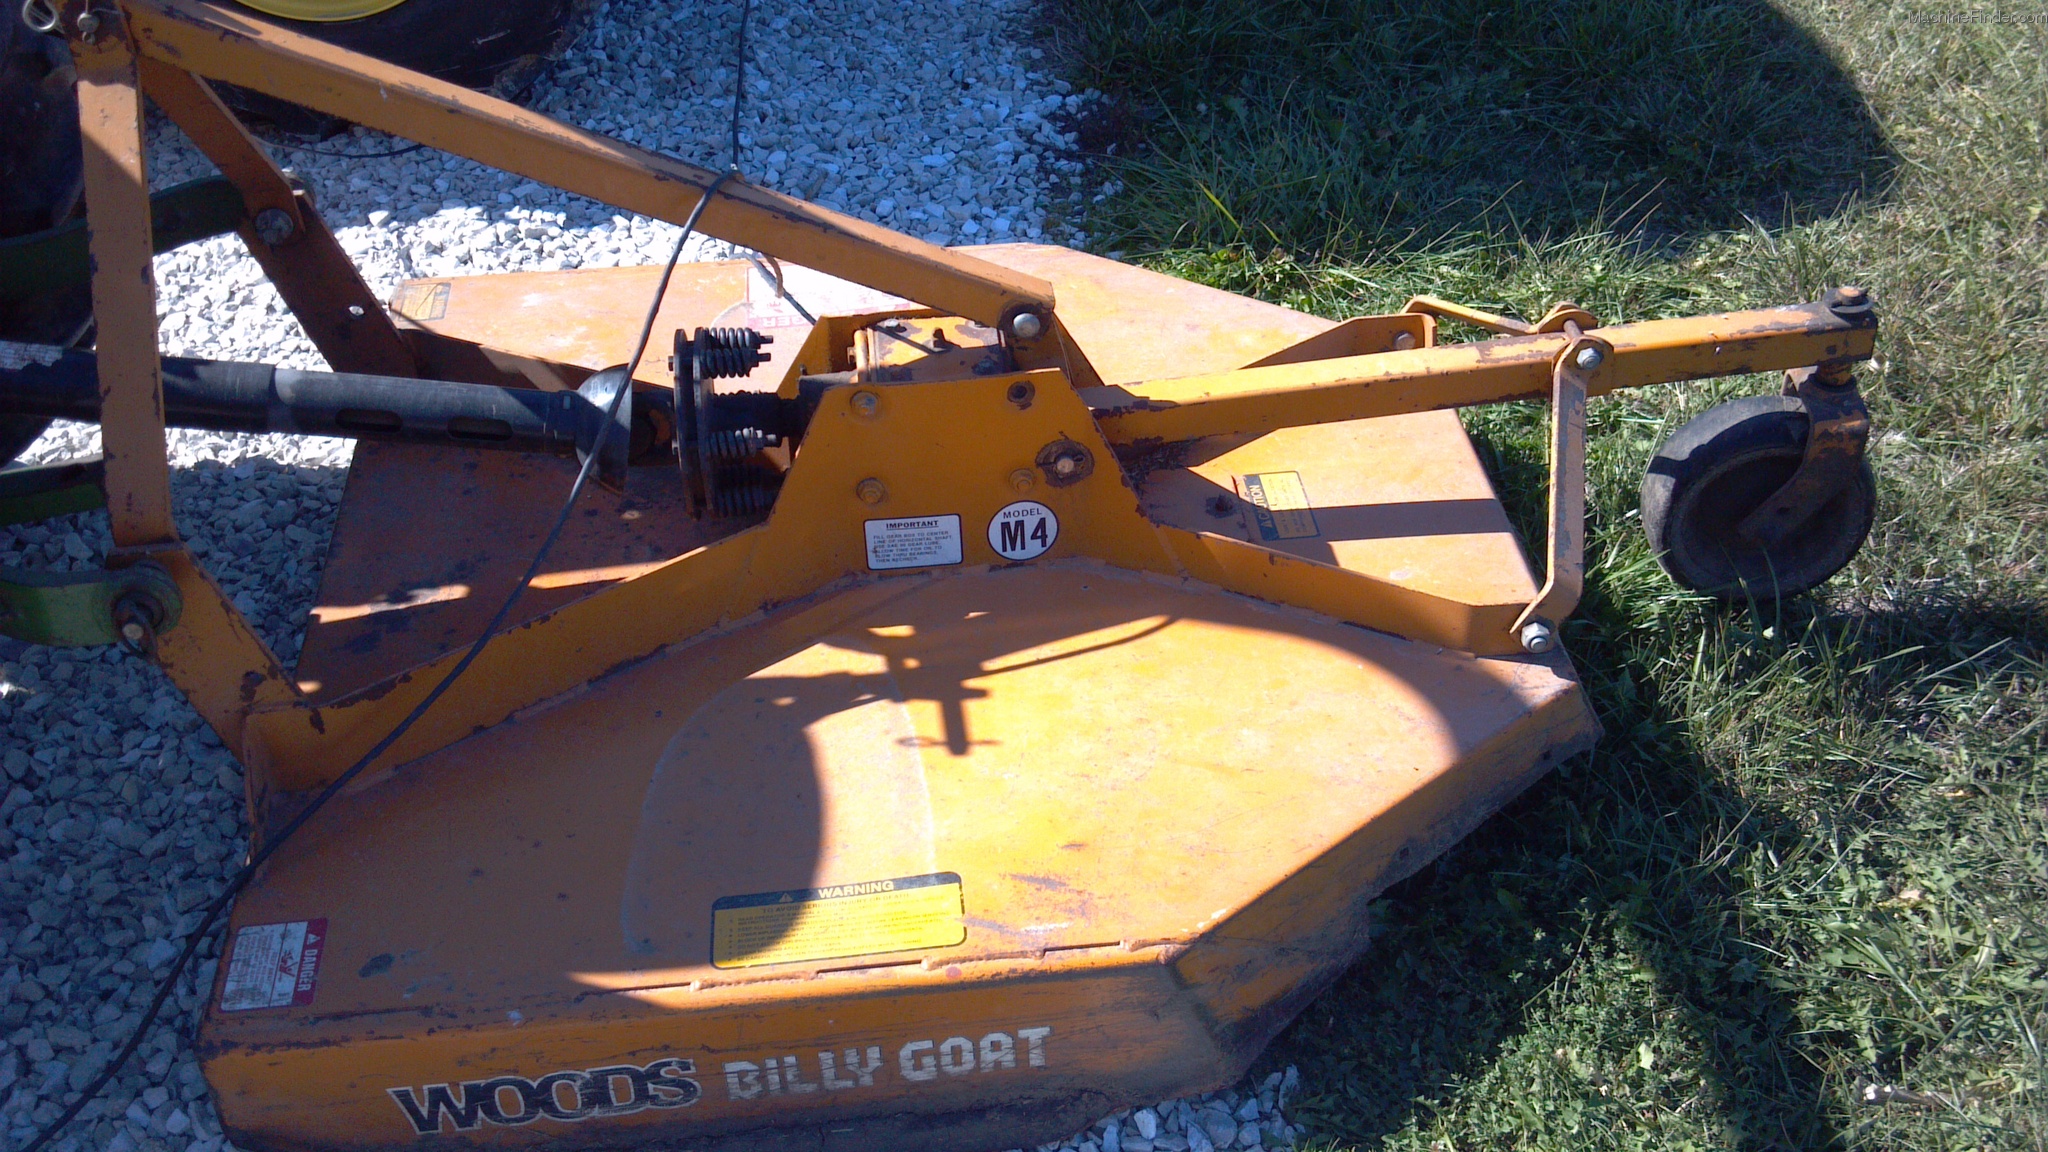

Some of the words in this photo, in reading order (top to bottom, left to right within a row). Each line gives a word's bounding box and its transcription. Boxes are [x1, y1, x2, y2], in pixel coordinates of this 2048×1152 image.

[1002, 507, 1043, 519] MODEL
[1249, 485, 1270, 520] CAUTION
[886, 520, 938, 529] IMPORTANT
[1000, 517, 1049, 553] M4
[818, 880, 894, 899] WARNING
[776, 904, 800, 912] AVOID
[297, 949, 318, 991] DANGER
[385, 1058, 701, 1135] WOODS
[721, 1045, 884, 1102] BILLY
[897, 1026, 1053, 1083] GOAT
